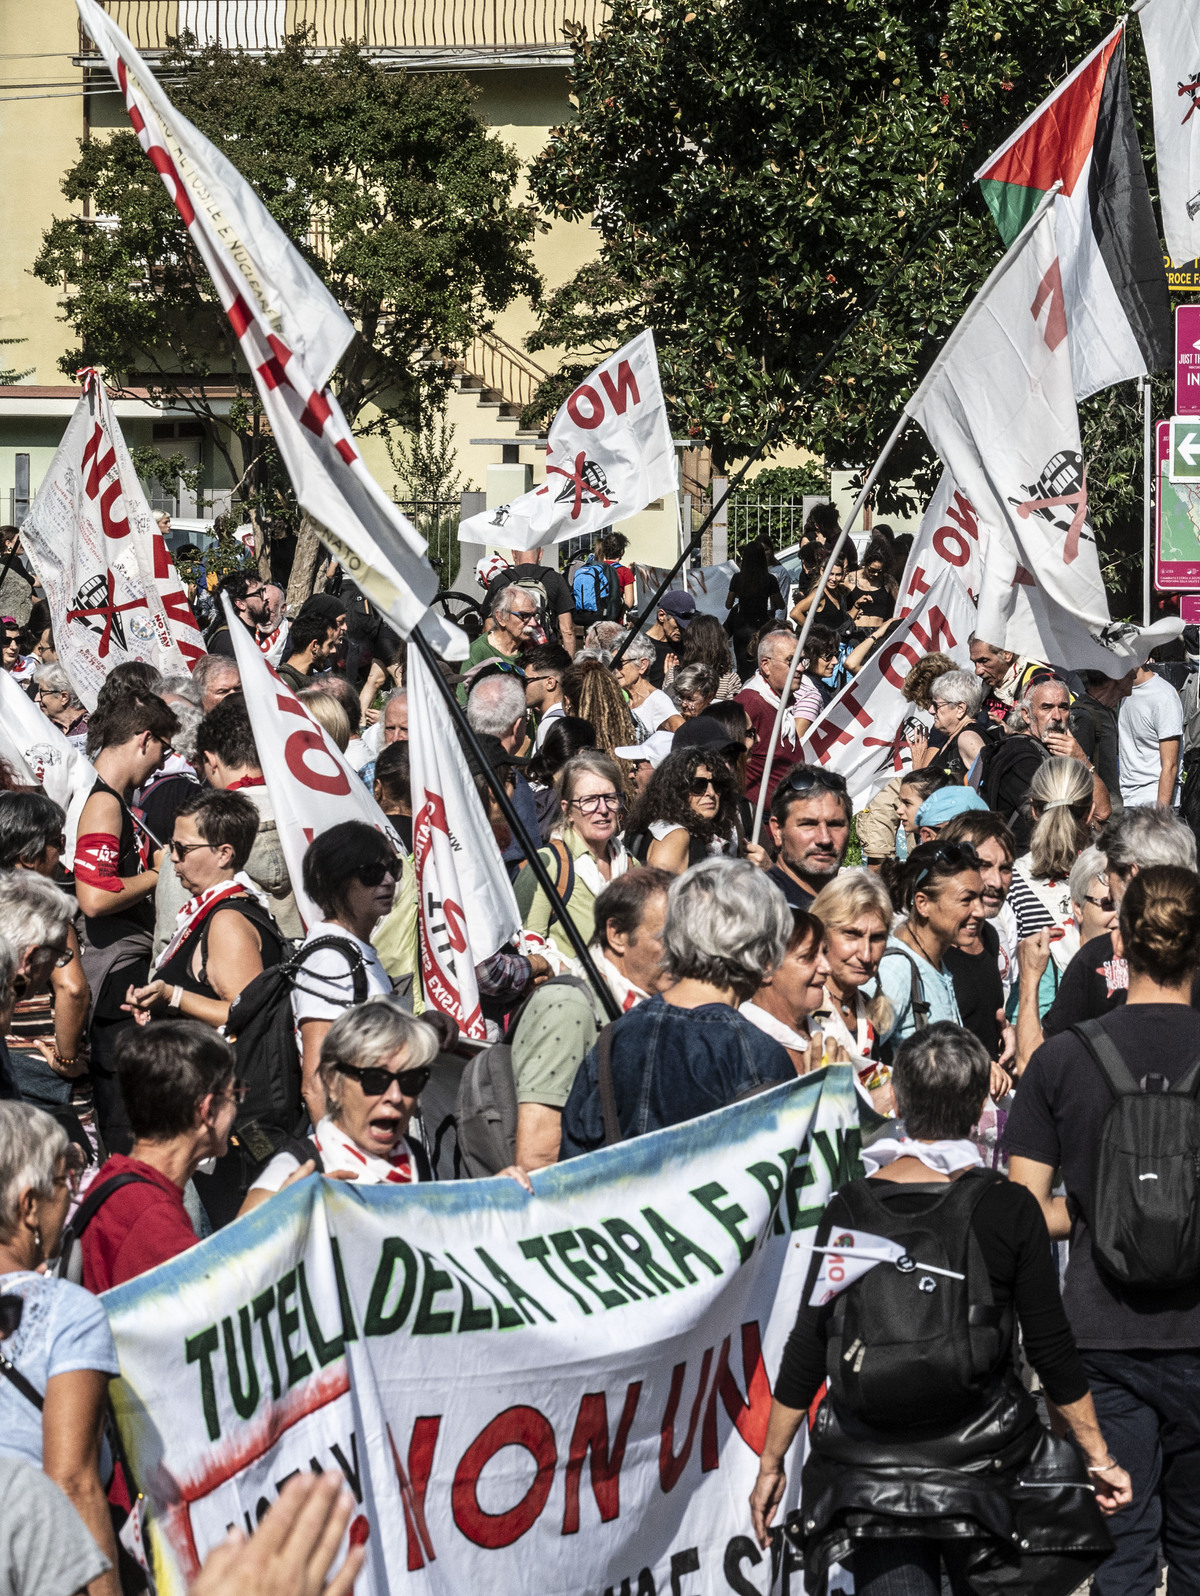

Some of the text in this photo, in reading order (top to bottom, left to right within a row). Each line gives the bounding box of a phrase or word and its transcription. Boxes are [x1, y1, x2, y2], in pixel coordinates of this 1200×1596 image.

[1166, 273, 1191, 284] ROCE
[1179, 354, 1193, 364] JUST
[321, 528, 362, 571] NATO
[154, 614, 164, 629] NO
[364, 1236, 556, 1337] DELLA
[517, 1205, 724, 1316] TERRA
[688, 1181, 757, 1266] E
